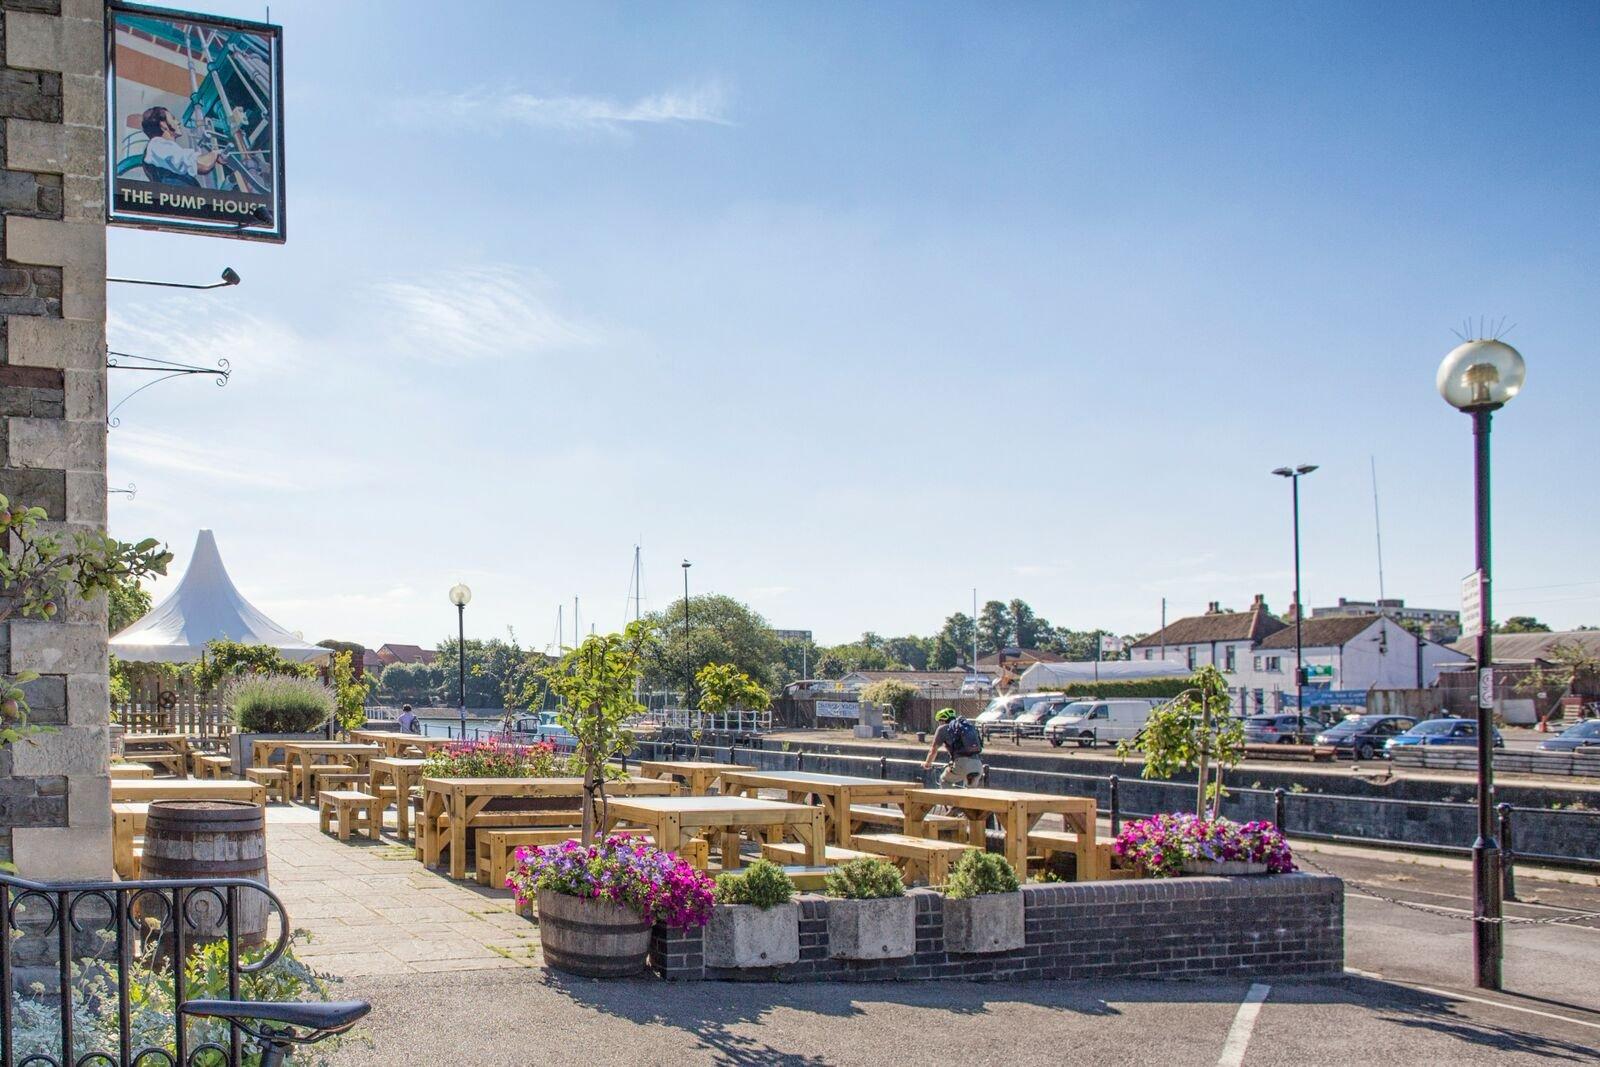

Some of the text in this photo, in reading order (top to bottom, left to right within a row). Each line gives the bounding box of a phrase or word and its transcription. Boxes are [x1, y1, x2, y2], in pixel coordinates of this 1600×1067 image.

[121, 188, 266, 215] THE PUMP HOUS
